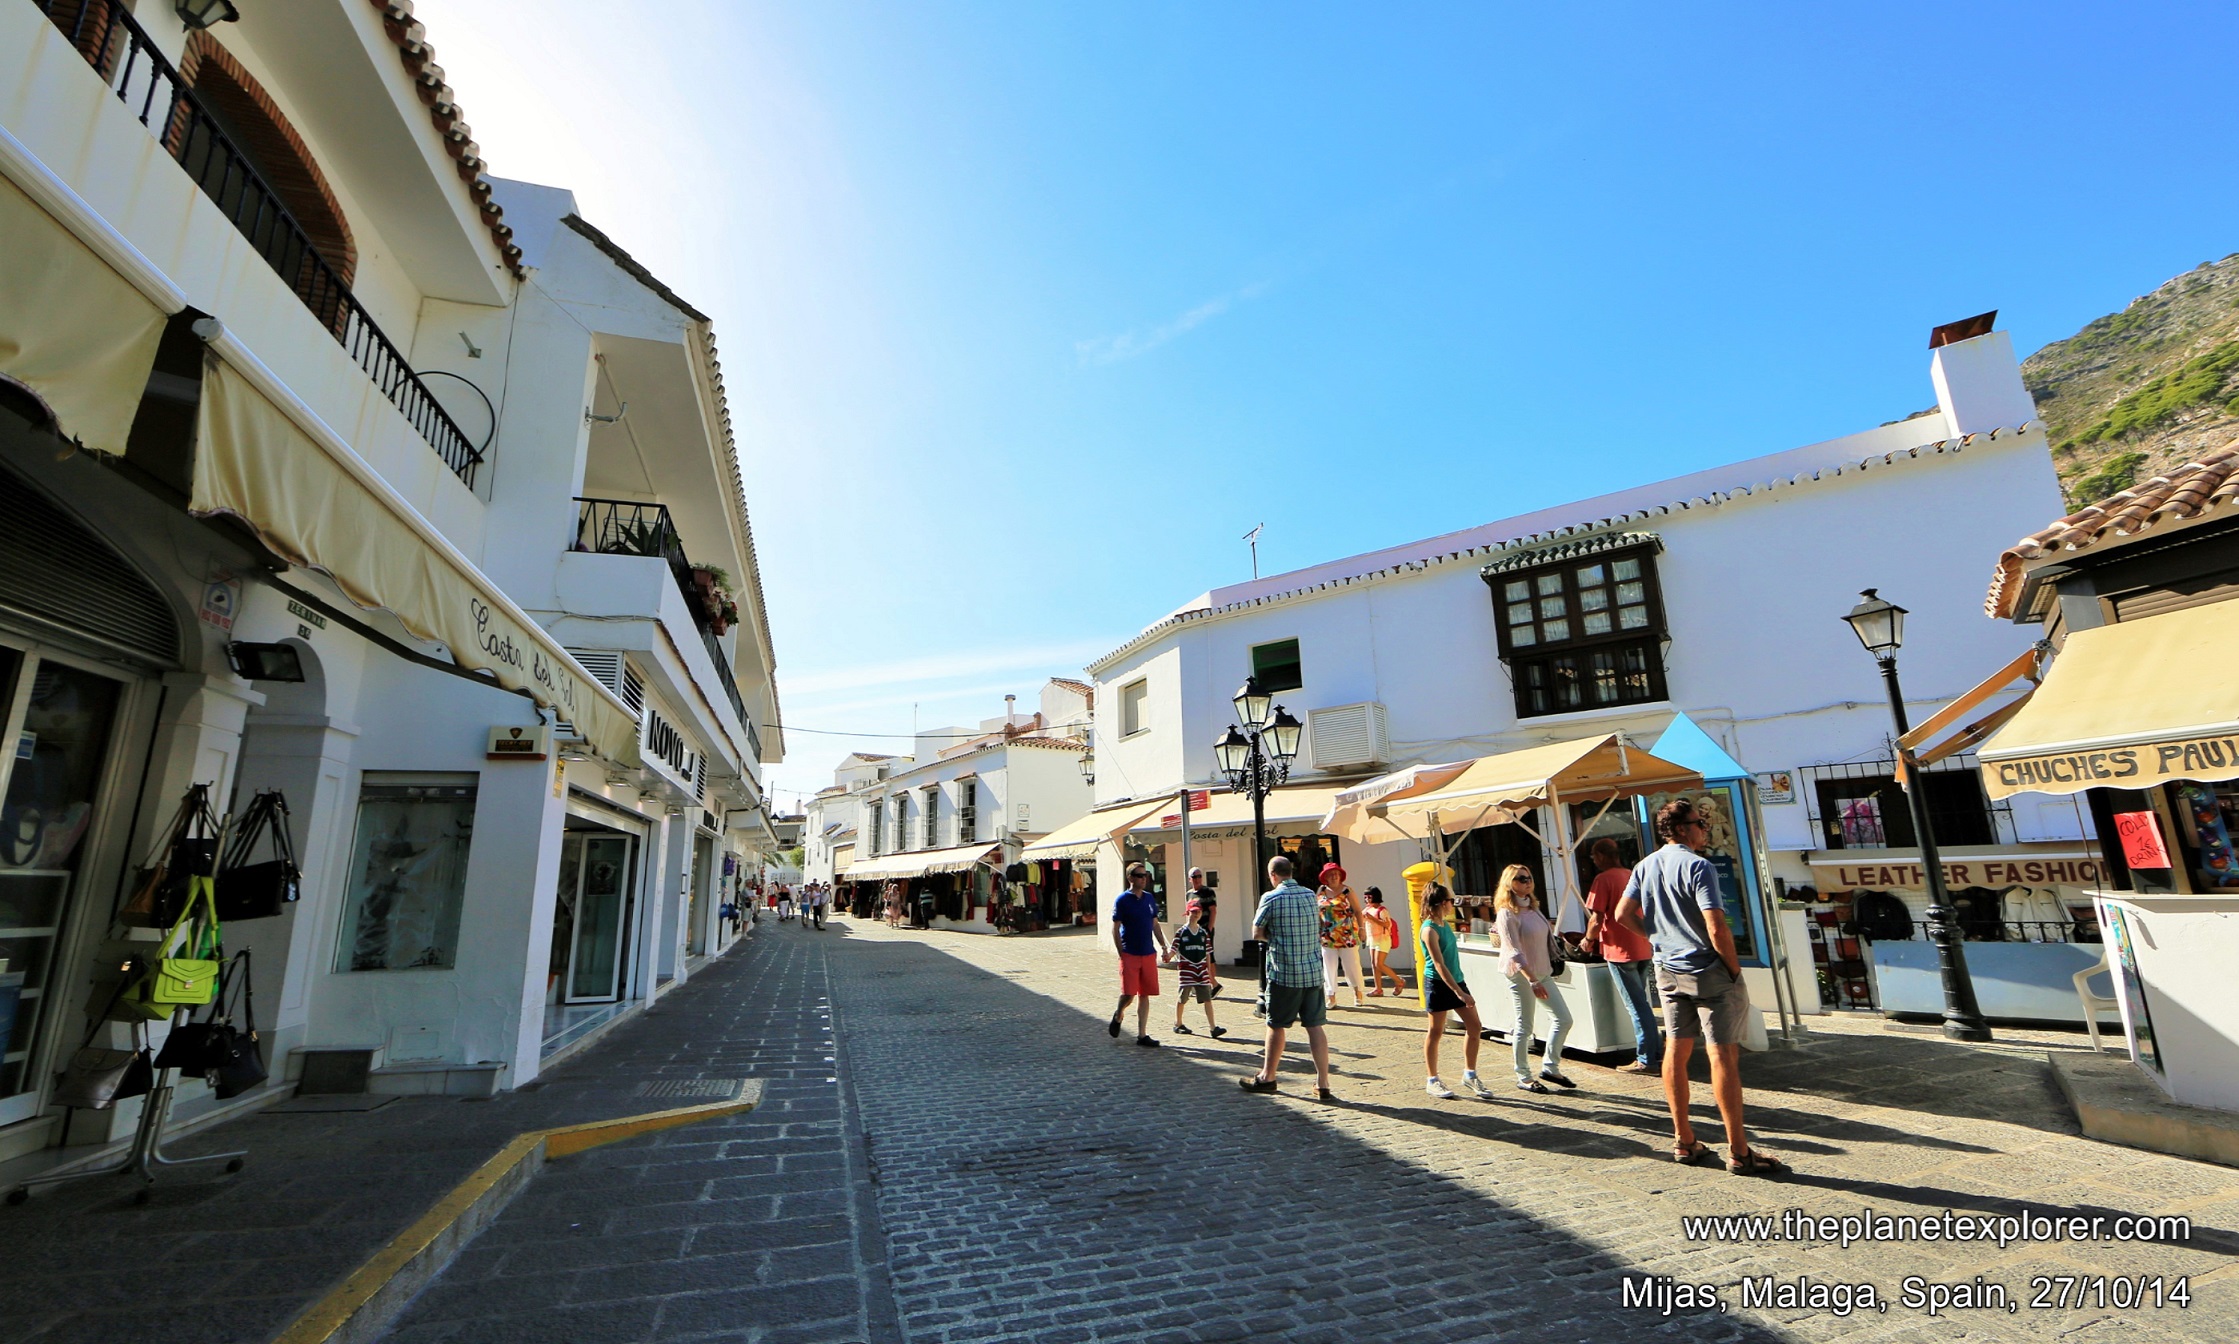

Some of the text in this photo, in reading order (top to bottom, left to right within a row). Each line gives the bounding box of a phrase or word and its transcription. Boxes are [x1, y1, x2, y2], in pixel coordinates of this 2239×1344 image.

[649, 710, 684, 771] NOVO
[2000, 750, 2138, 785] CHUCHES
[1226, 827, 1248, 837] del
[2120, 814, 2149, 836] COLD
[2130, 845, 2166, 865] DRINK
